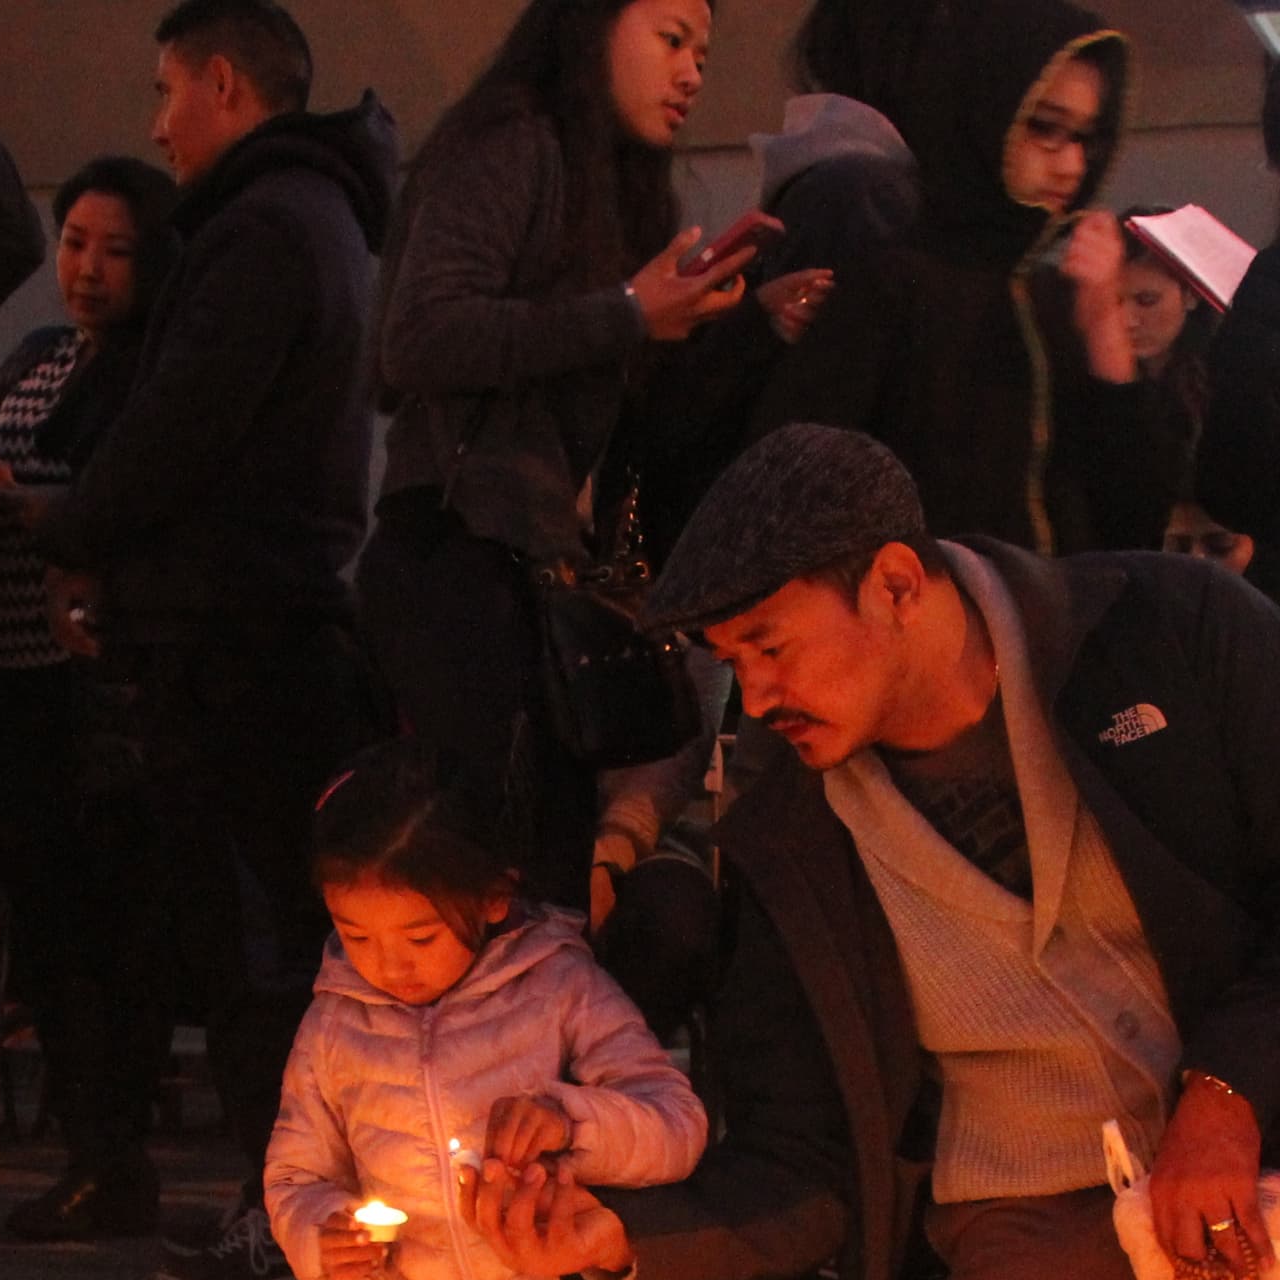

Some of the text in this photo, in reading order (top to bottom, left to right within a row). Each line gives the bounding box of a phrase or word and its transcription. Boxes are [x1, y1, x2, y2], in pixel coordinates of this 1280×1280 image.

[1112, 706, 1137, 725] THE
[1099, 718, 1143, 743] NORTH
[1115, 726, 1145, 747] FACE
